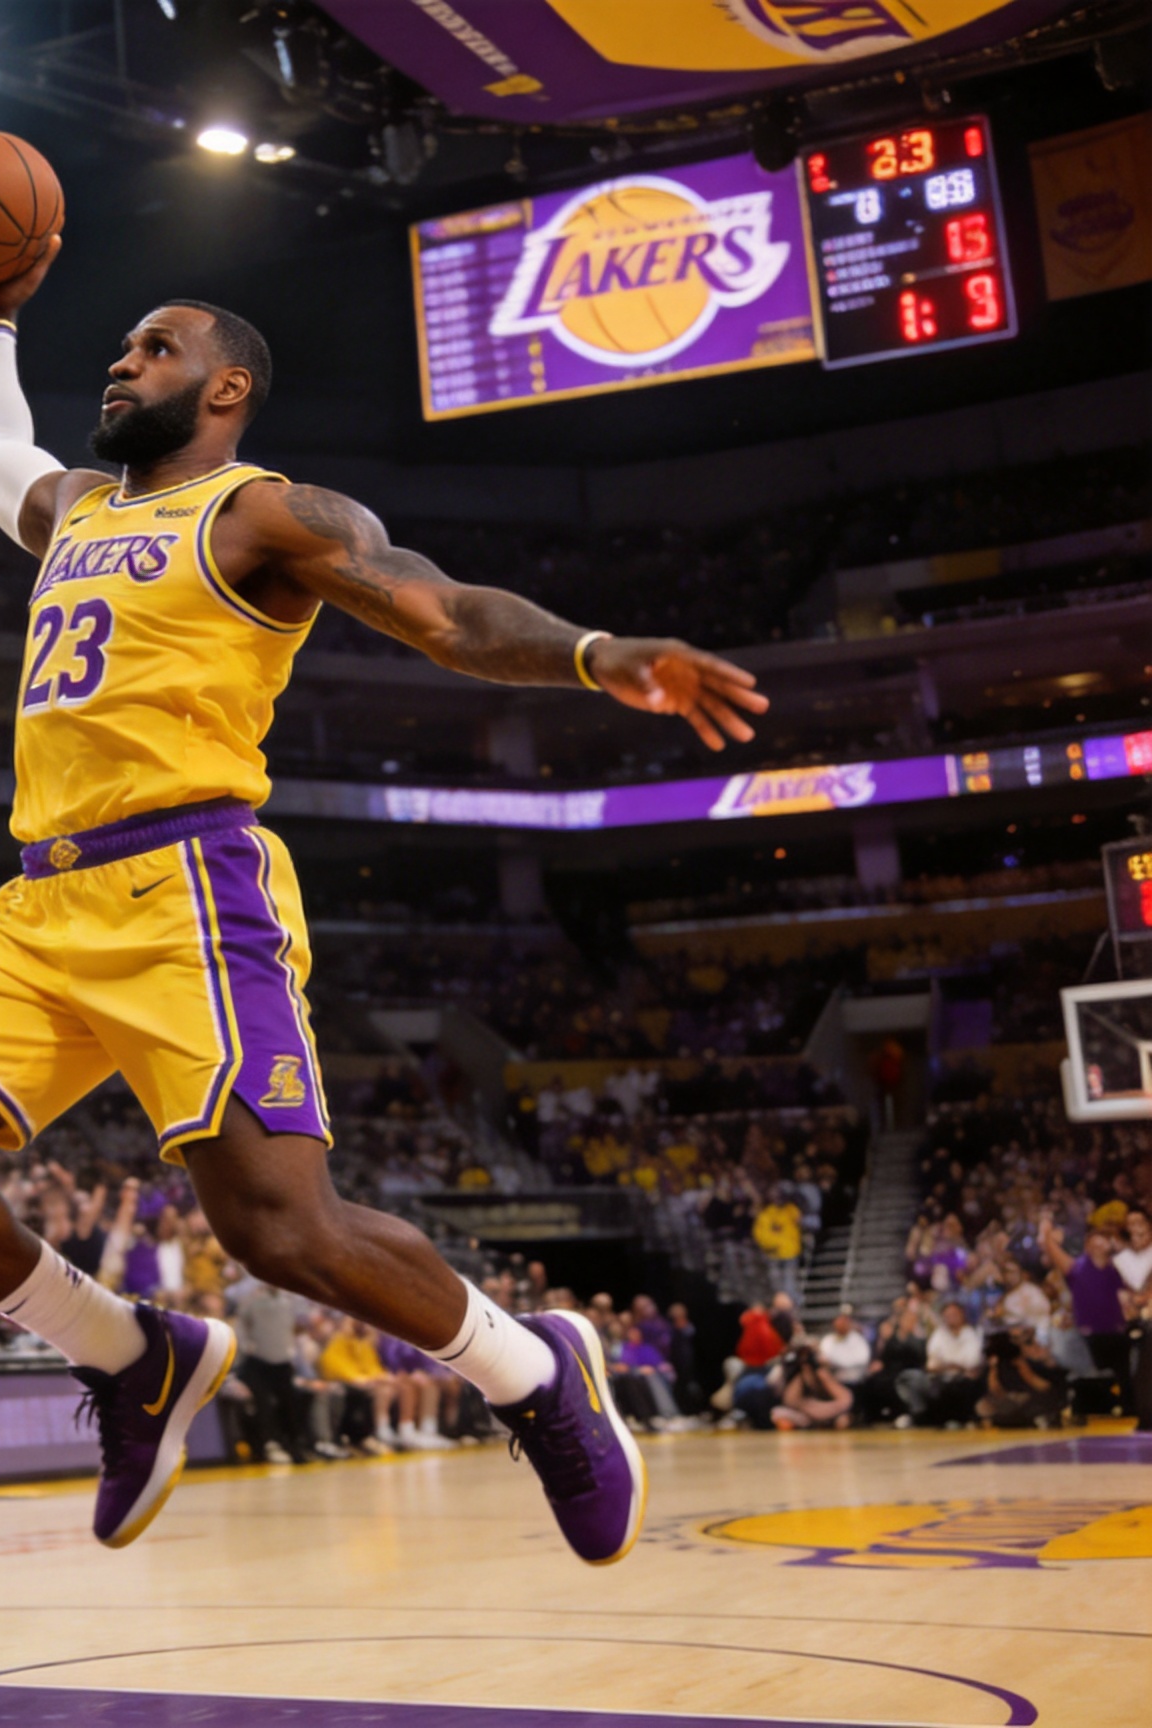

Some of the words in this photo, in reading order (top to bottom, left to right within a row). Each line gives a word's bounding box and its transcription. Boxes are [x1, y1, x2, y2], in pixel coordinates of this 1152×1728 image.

[508, 214, 764, 323] LAKERS
[29, 532, 181, 605] LAKERS
[22, 597, 114, 716] 23
